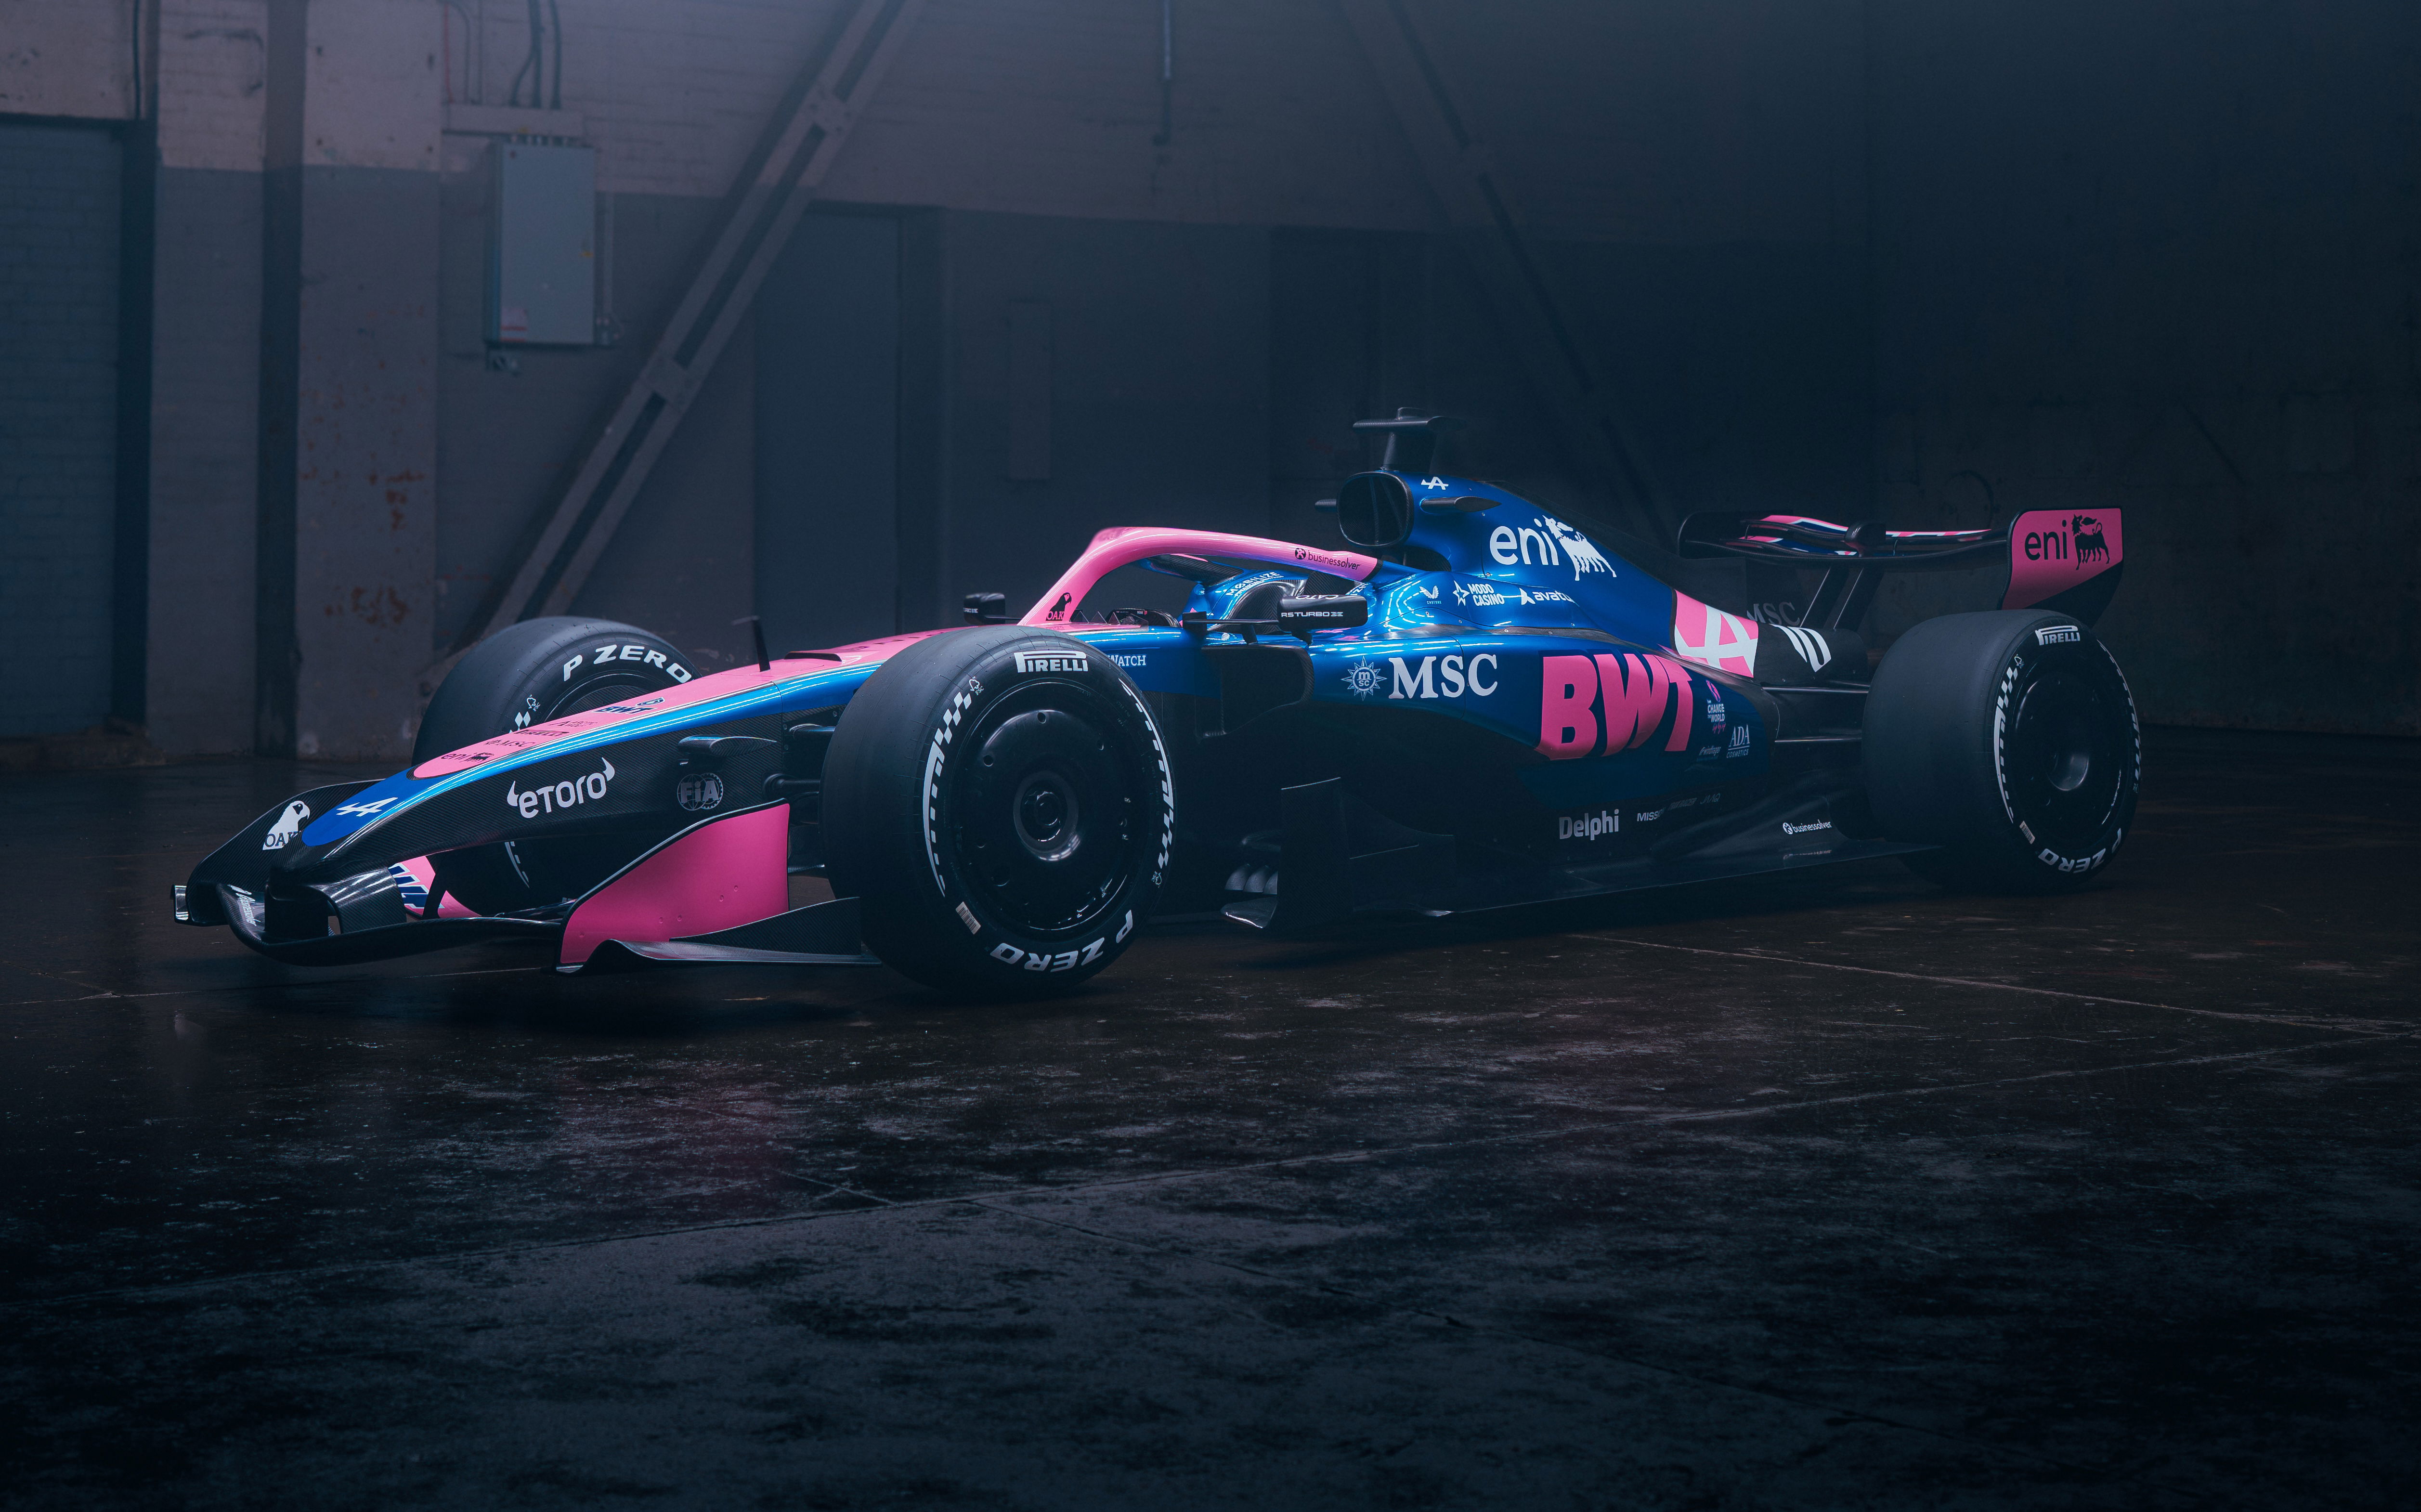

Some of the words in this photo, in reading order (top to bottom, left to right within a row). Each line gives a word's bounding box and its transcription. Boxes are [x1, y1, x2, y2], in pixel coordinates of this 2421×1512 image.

[1489, 519, 1559, 566] eni
[2025, 520, 2068, 561] eni
[1308, 550, 1360, 570] businessolver
[1225, 572, 1280, 596] MOBILIZE
[1467, 583, 1495, 595] MODO
[1472, 593, 1505, 606] CASINO
[1746, 602, 1800, 626] MSC
[2035, 625, 2080, 646] PIRELLI
[564, 654, 583, 682] P
[593, 644, 692, 684] ZERO
[1014, 650, 1088, 673] PIRELLI
[1388, 654, 1498, 700] MSC
[1534, 653, 1693, 761] BWT
[1707, 704, 1725, 714] CHANGE
[1711, 714, 1725, 723] WORLD
[1728, 723, 1750, 747] ADA
[1726, 748, 1749, 758] COSMETICS
[1560, 809, 1619, 841] Delphi
[1791, 819, 1832, 833] businessolver
[2038, 847, 2107, 874] ZERO
[1116, 910, 1133, 943] P
[990, 937, 1105, 973] ZERO
